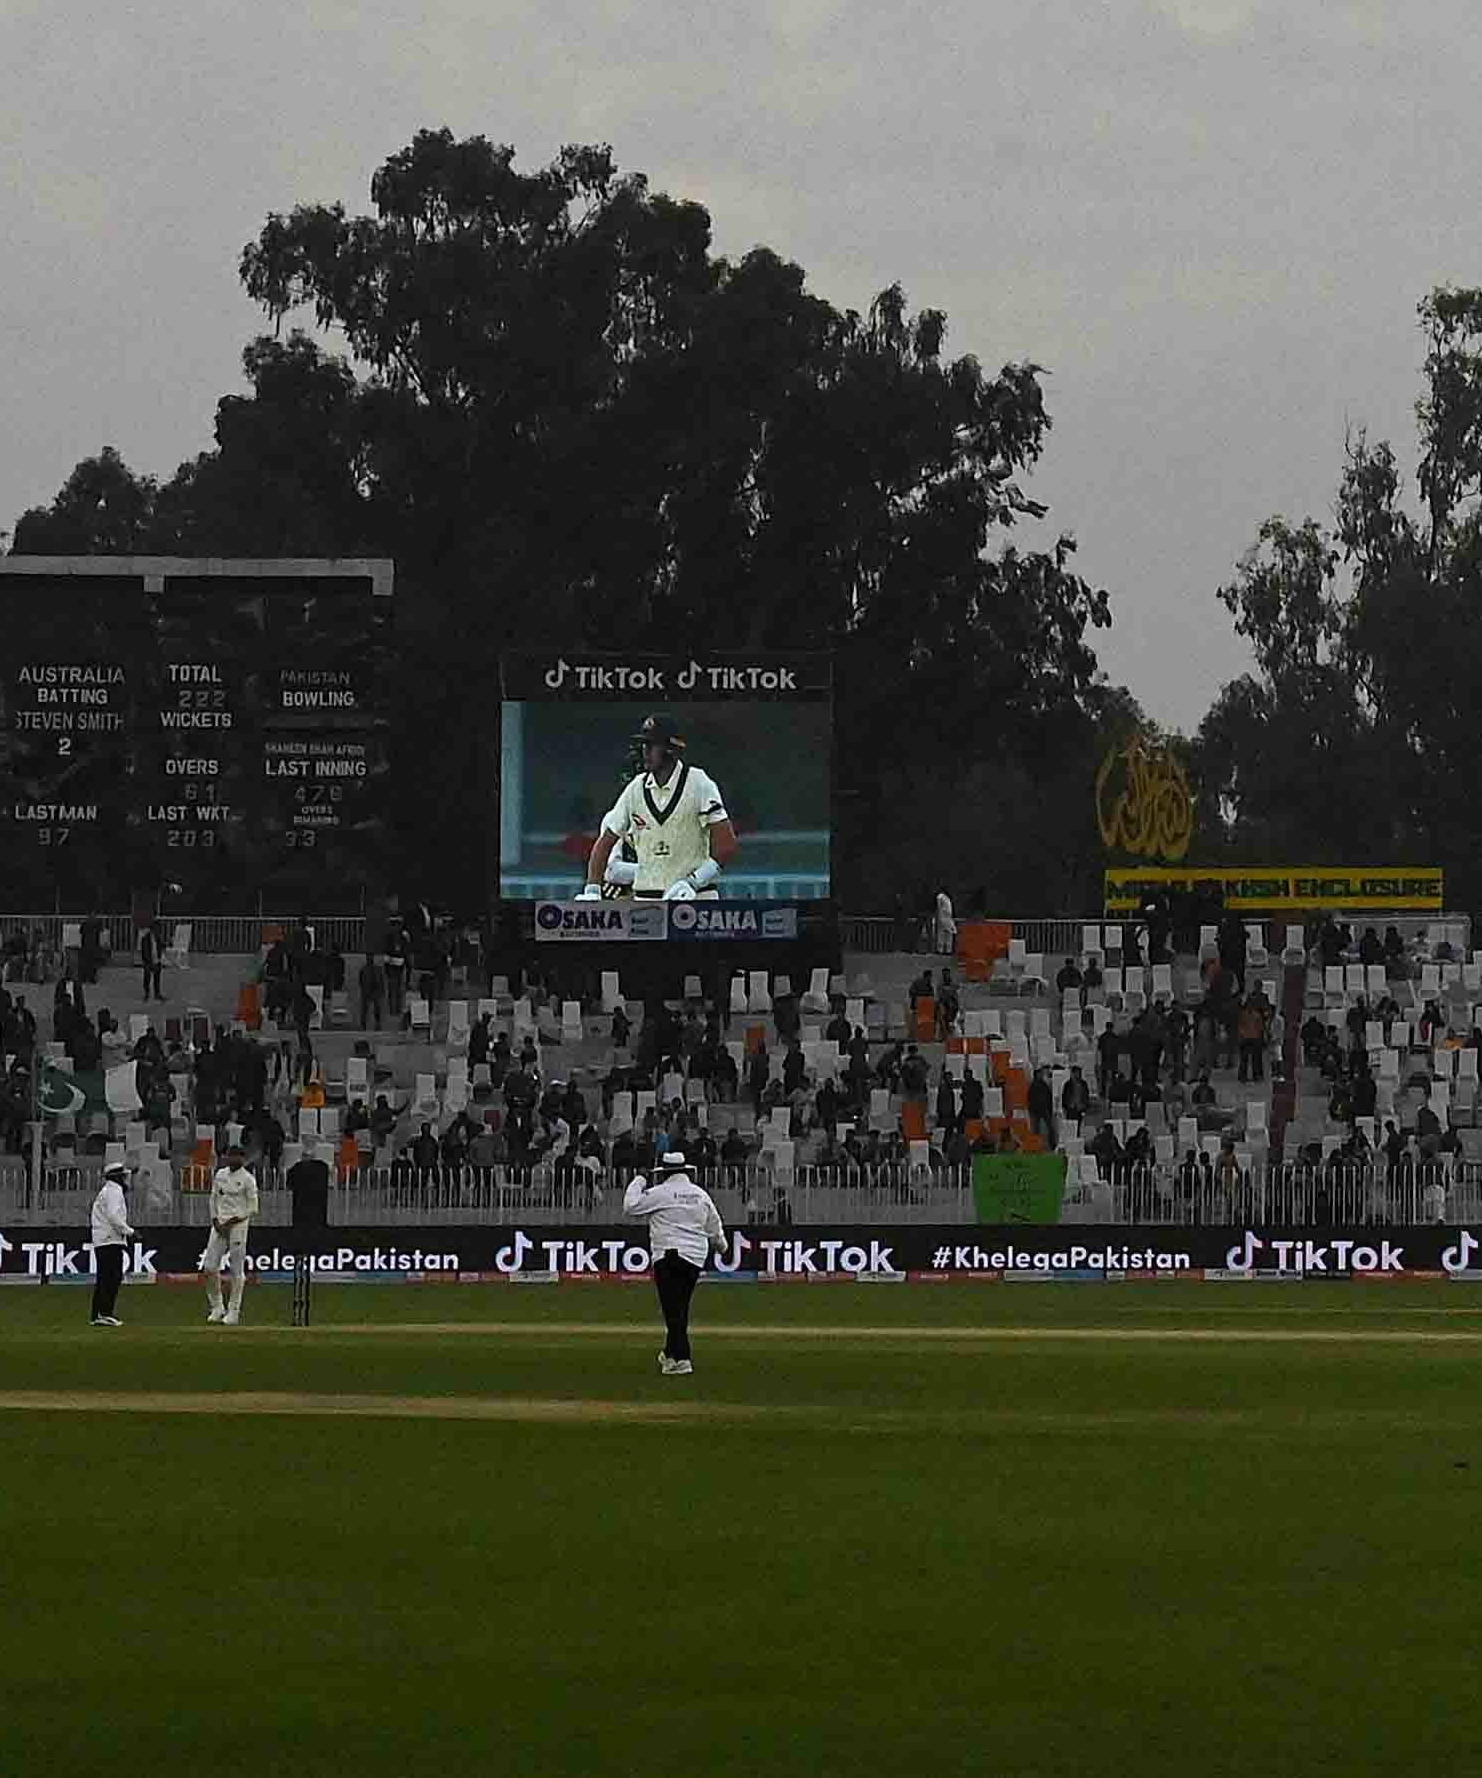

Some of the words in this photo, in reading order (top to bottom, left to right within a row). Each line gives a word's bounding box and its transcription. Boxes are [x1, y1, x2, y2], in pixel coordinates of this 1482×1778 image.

[18, 666, 126, 685] AUSTRALIA
[169, 663, 222, 683] TOTAL
[280, 670, 350, 685] PAKISTAN
[575, 666, 665, 690] TikTok
[706, 666, 799, 691] TikTok
[37, 687, 108, 705] BATTING
[282, 690, 355, 708] BOWLING
[14, 710, 74, 730] STEVEN
[77, 710, 125, 731] SMITH
[160, 710, 233, 728] WICKETS
[58, 737, 71, 756] 2
[165, 759, 220, 775] OVERS
[265, 758, 310, 777] LAST
[315, 759, 367, 777] INNING
[148, 805, 188, 822] LAST
[196, 805, 231, 822] WKT
[537, 904, 623, 930] OSAKA
[672, 903, 759, 931] OSAKA
[542, 1241, 651, 1272] TikTo
[760, 1240, 894, 1272] TikTok
[931, 1245, 1190, 1274] #KhelegaPakistan
[1271, 1240, 1405, 1271] TikTok
